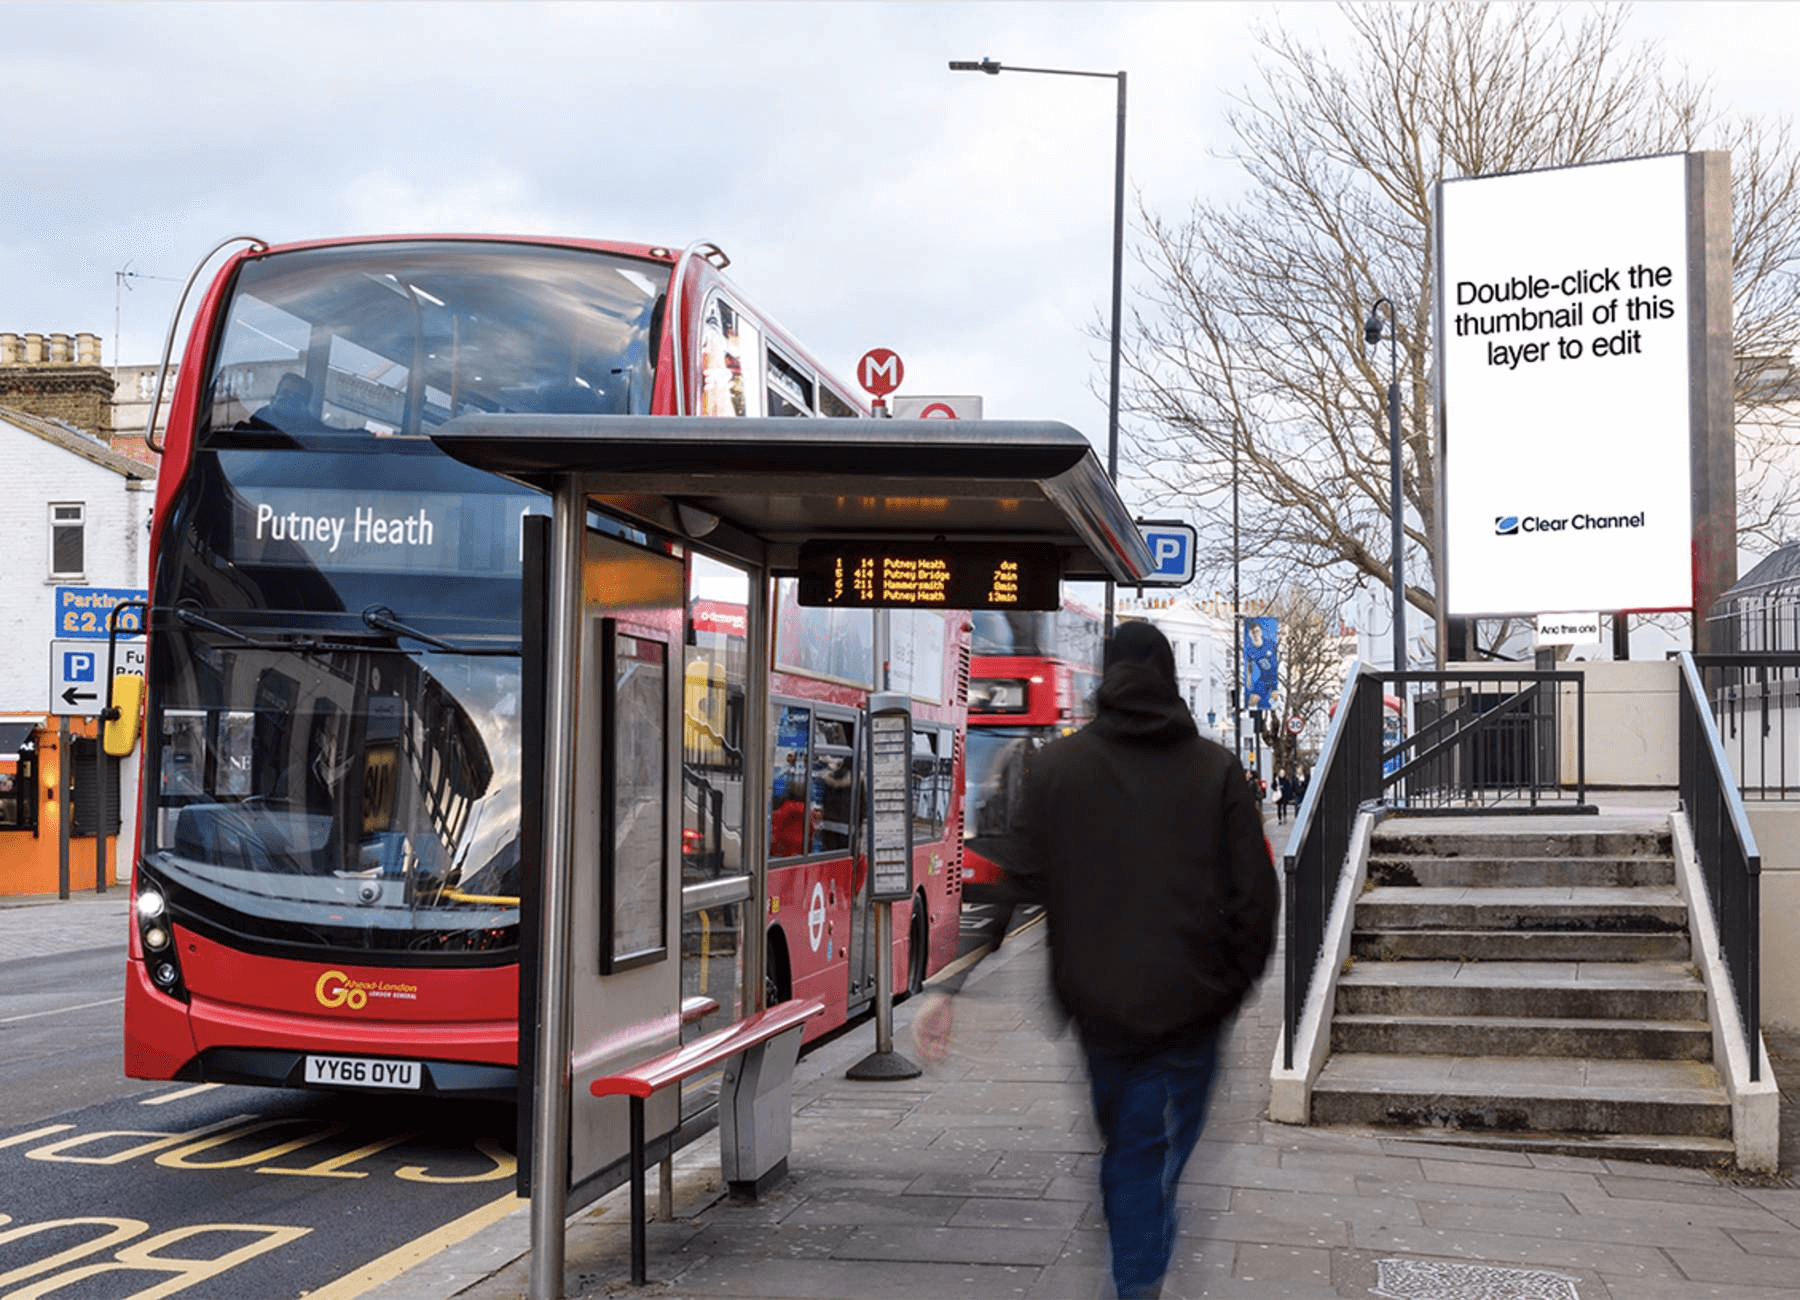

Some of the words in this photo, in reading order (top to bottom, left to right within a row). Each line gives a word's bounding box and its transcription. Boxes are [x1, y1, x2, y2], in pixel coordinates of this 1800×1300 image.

[1456, 267, 1621, 306] Double-click
[1627, 264, 1673, 290] the
[1454, 301, 1583, 337] thumbnail
[1592, 298, 1618, 325] of
[1626, 294, 1675, 322] this
[1487, 341, 1550, 370] layer
[1558, 336, 1584, 360] to
[1591, 330, 1642, 358] edit
[865, 355, 898, 388] M
[256, 503, 345, 552] Putney
[353, 506, 434, 545] Heath
[1521, 516, 1568, 532] Clear
[1571, 511, 1645, 530] Channel
[836, 558, 843, 568] 1
[861, 558, 874, 568] 14
[883, 558, 917, 571] Putney
[918, 558, 946, 570] Heath
[1000, 561, 1018, 571] due
[1155, 538, 1181, 570] P
[835, 568, 843, 578] 5
[854, 568, 874, 579] 414
[883, 568, 917, 581] Putney
[918, 570, 951, 582] Bridge
[993, 570, 1018, 582] 7min
[835, 578, 843, 589] 6
[854, 579, 873, 589] 211
[883, 579, 945, 590] Hammersmith
[860, 590, 874, 600] 14
[883, 590, 916, 602] Putney
[917, 591, 946, 601] Heath
[1540, 625, 1559, 635] And
[1561, 624, 1578, 635] this
[1579, 624, 1597, 634] one
[71, 655, 90, 679] P
[315, 970, 368, 1010] Go
[315, 1059, 366, 1081] YY66
[372, 1063, 412, 1084] OYU
